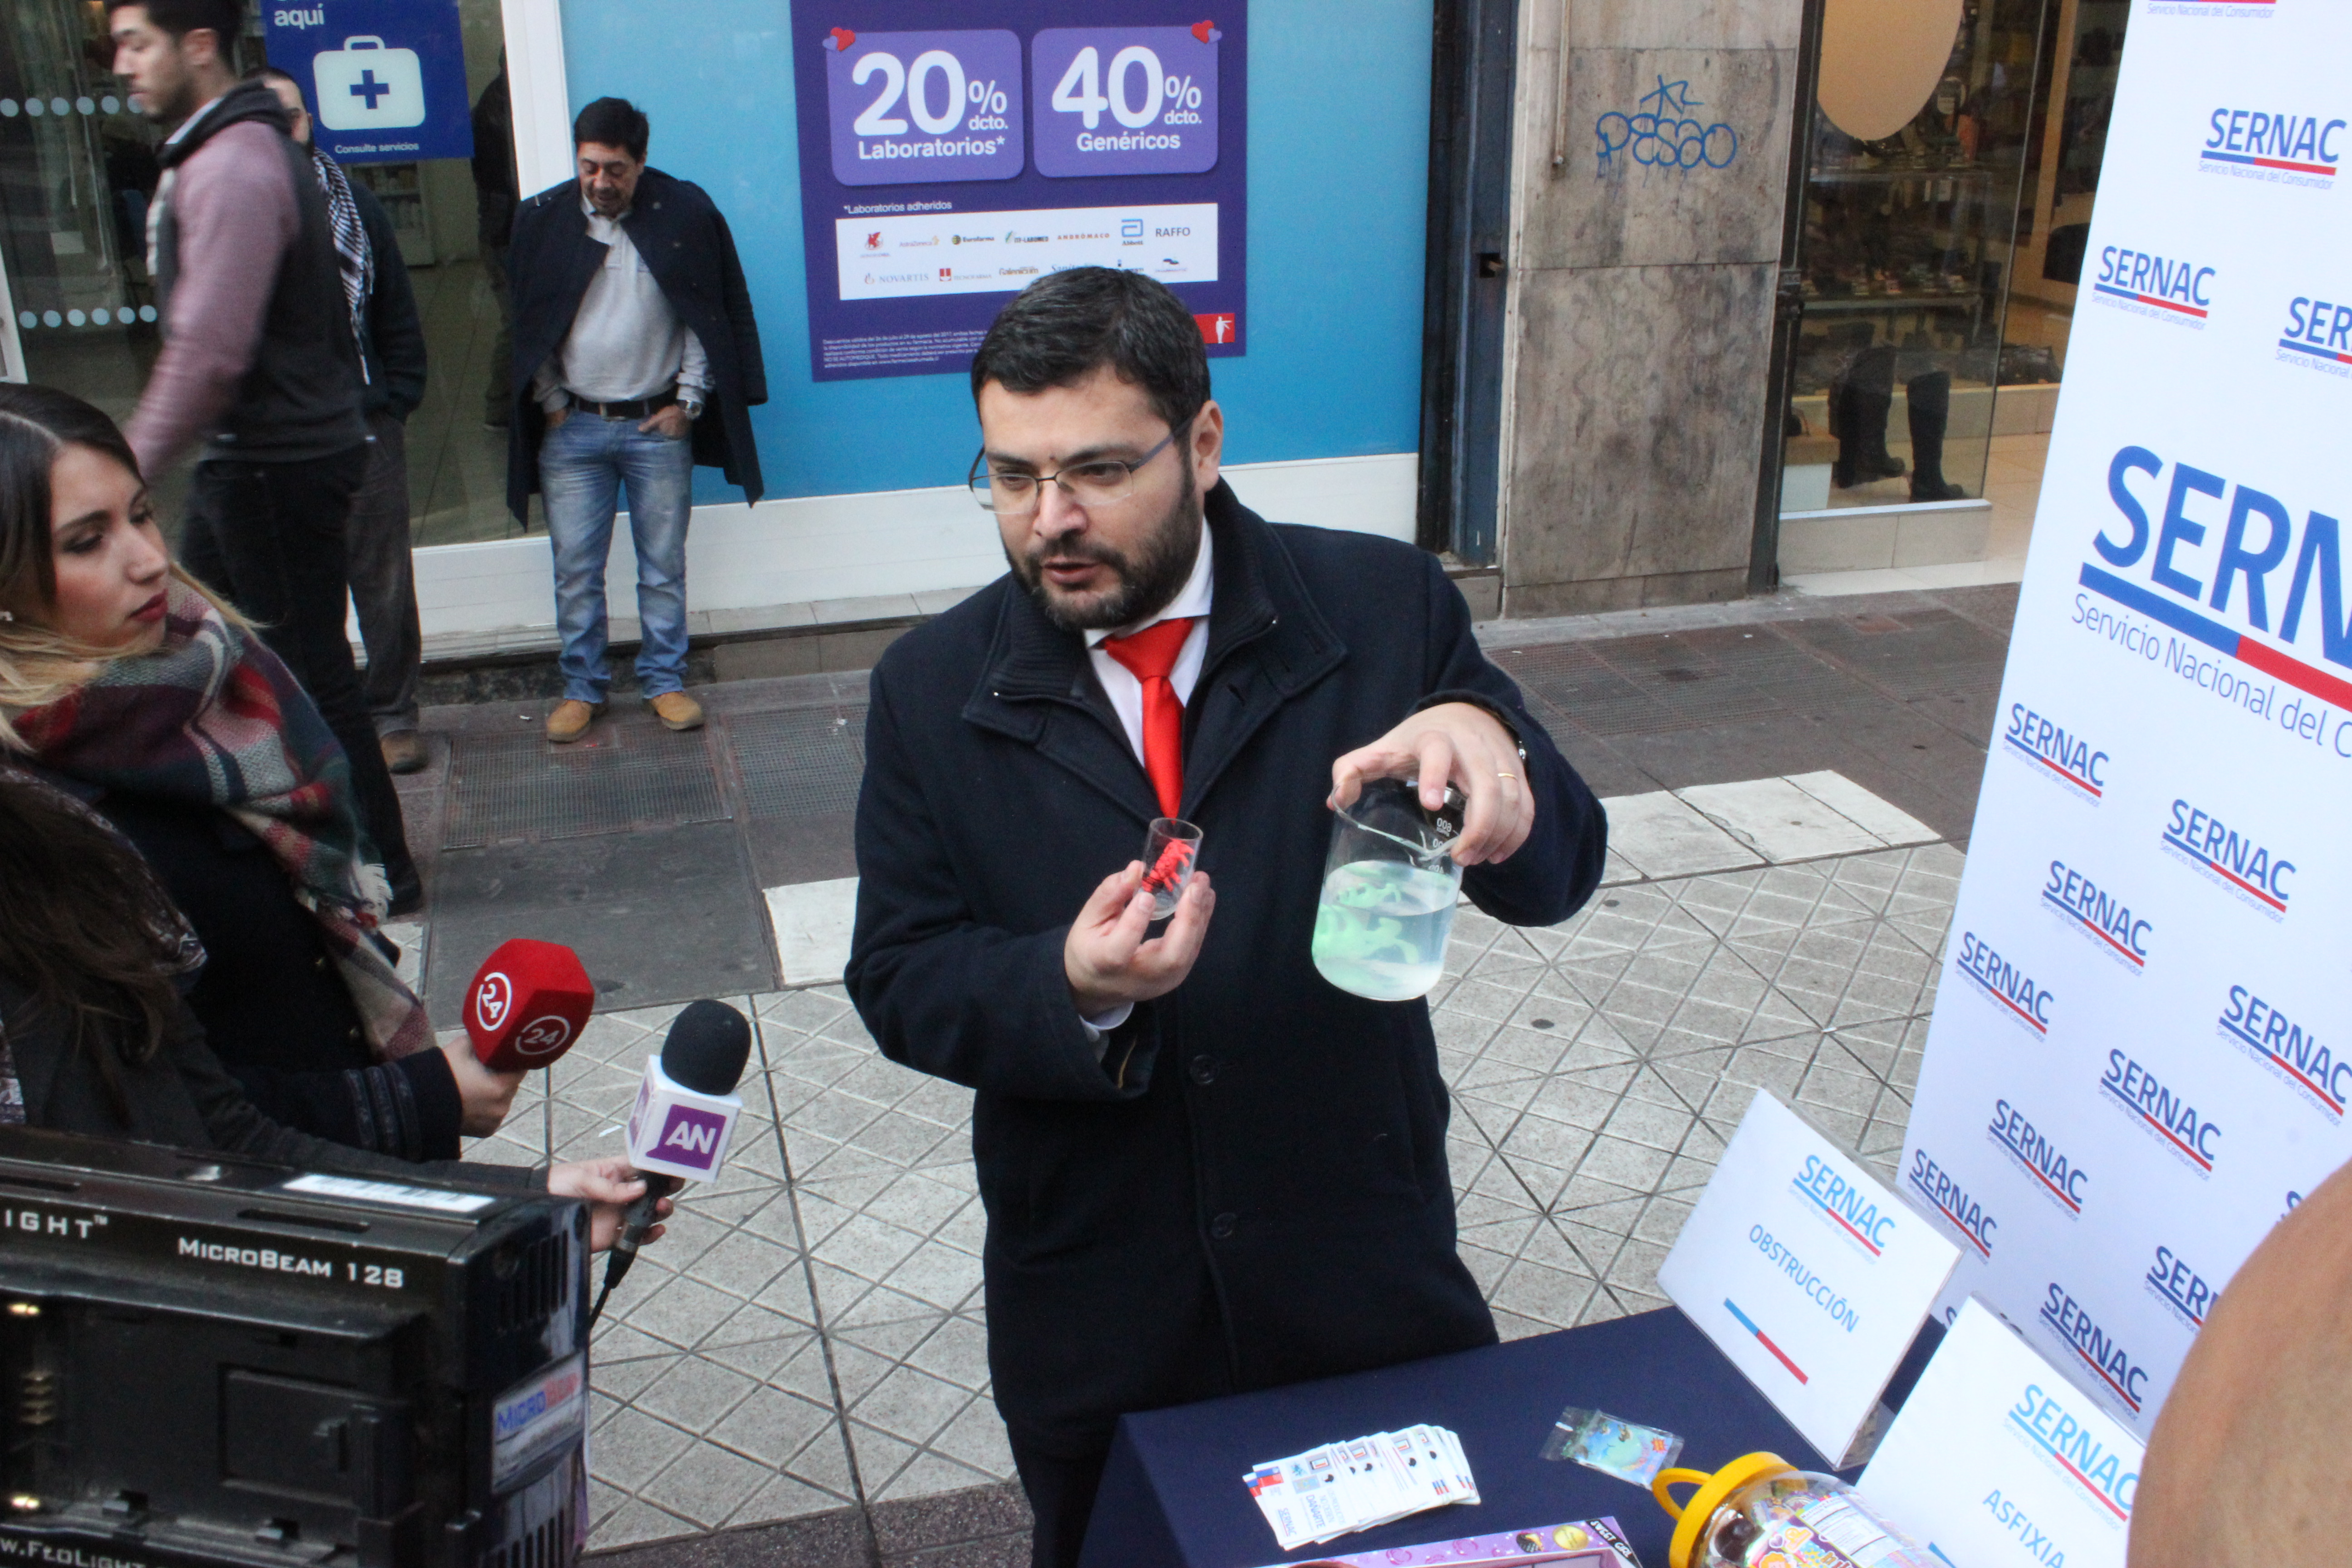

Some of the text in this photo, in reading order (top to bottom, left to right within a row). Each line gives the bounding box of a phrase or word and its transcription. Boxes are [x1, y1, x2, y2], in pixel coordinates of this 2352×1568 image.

[852, 49, 1007, 137] 20%
[969, 112, 1009, 131] dcto.
[1051, 45, 1202, 129] 40%
[1164, 109, 1202, 125] dcto.
[334, 144, 376, 153] Consulte
[1077, 131, 1181, 151] Genéricos
[2206, 108, 2347, 163] SERNAC
[907, 201, 952, 211] adheridos
[1156, 227, 1191, 237] RAFFO
[879, 273, 929, 283] NOVARTIS
[2098, 245, 2216, 306] SERNAC
[2071, 593, 2160, 661] Servicio
[2164, 637, 2275, 720] Nacional
[2280, 698, 2327, 746] del
[2008, 703, 2109, 787] SERNAC
[2167, 799, 2296, 900] SERNAC
[2046, 860, 2152, 956] SERNAC
[481, 983, 503, 1019] 24
[1960, 931, 2053, 1024] SERNAC
[524, 1028, 557, 1044] 24
[2224, 985, 2352, 1104] SERNAC
[664, 1121, 716, 1154] AN
[2105, 1049, 2221, 1161] SERNAC
[1992, 1099, 2088, 1204] SERNAC
[1798, 1155, 1896, 1248] SERNAC
[1912, 1148, 1997, 1249] SERNAC
[347, 1263, 404, 1289] 128
[1749, 1224, 1859, 1333] OBSTRUCCIÓN
[2044, 1283, 2148, 1403] SERNAC
[2015, 1384, 2139, 1511] SERNAC
[1280, 1508, 1297, 1536] SERNAC
[1306, 1494, 1325, 1528] DAÑARTE
[1982, 1489, 2065, 1568] ASFIXIA
